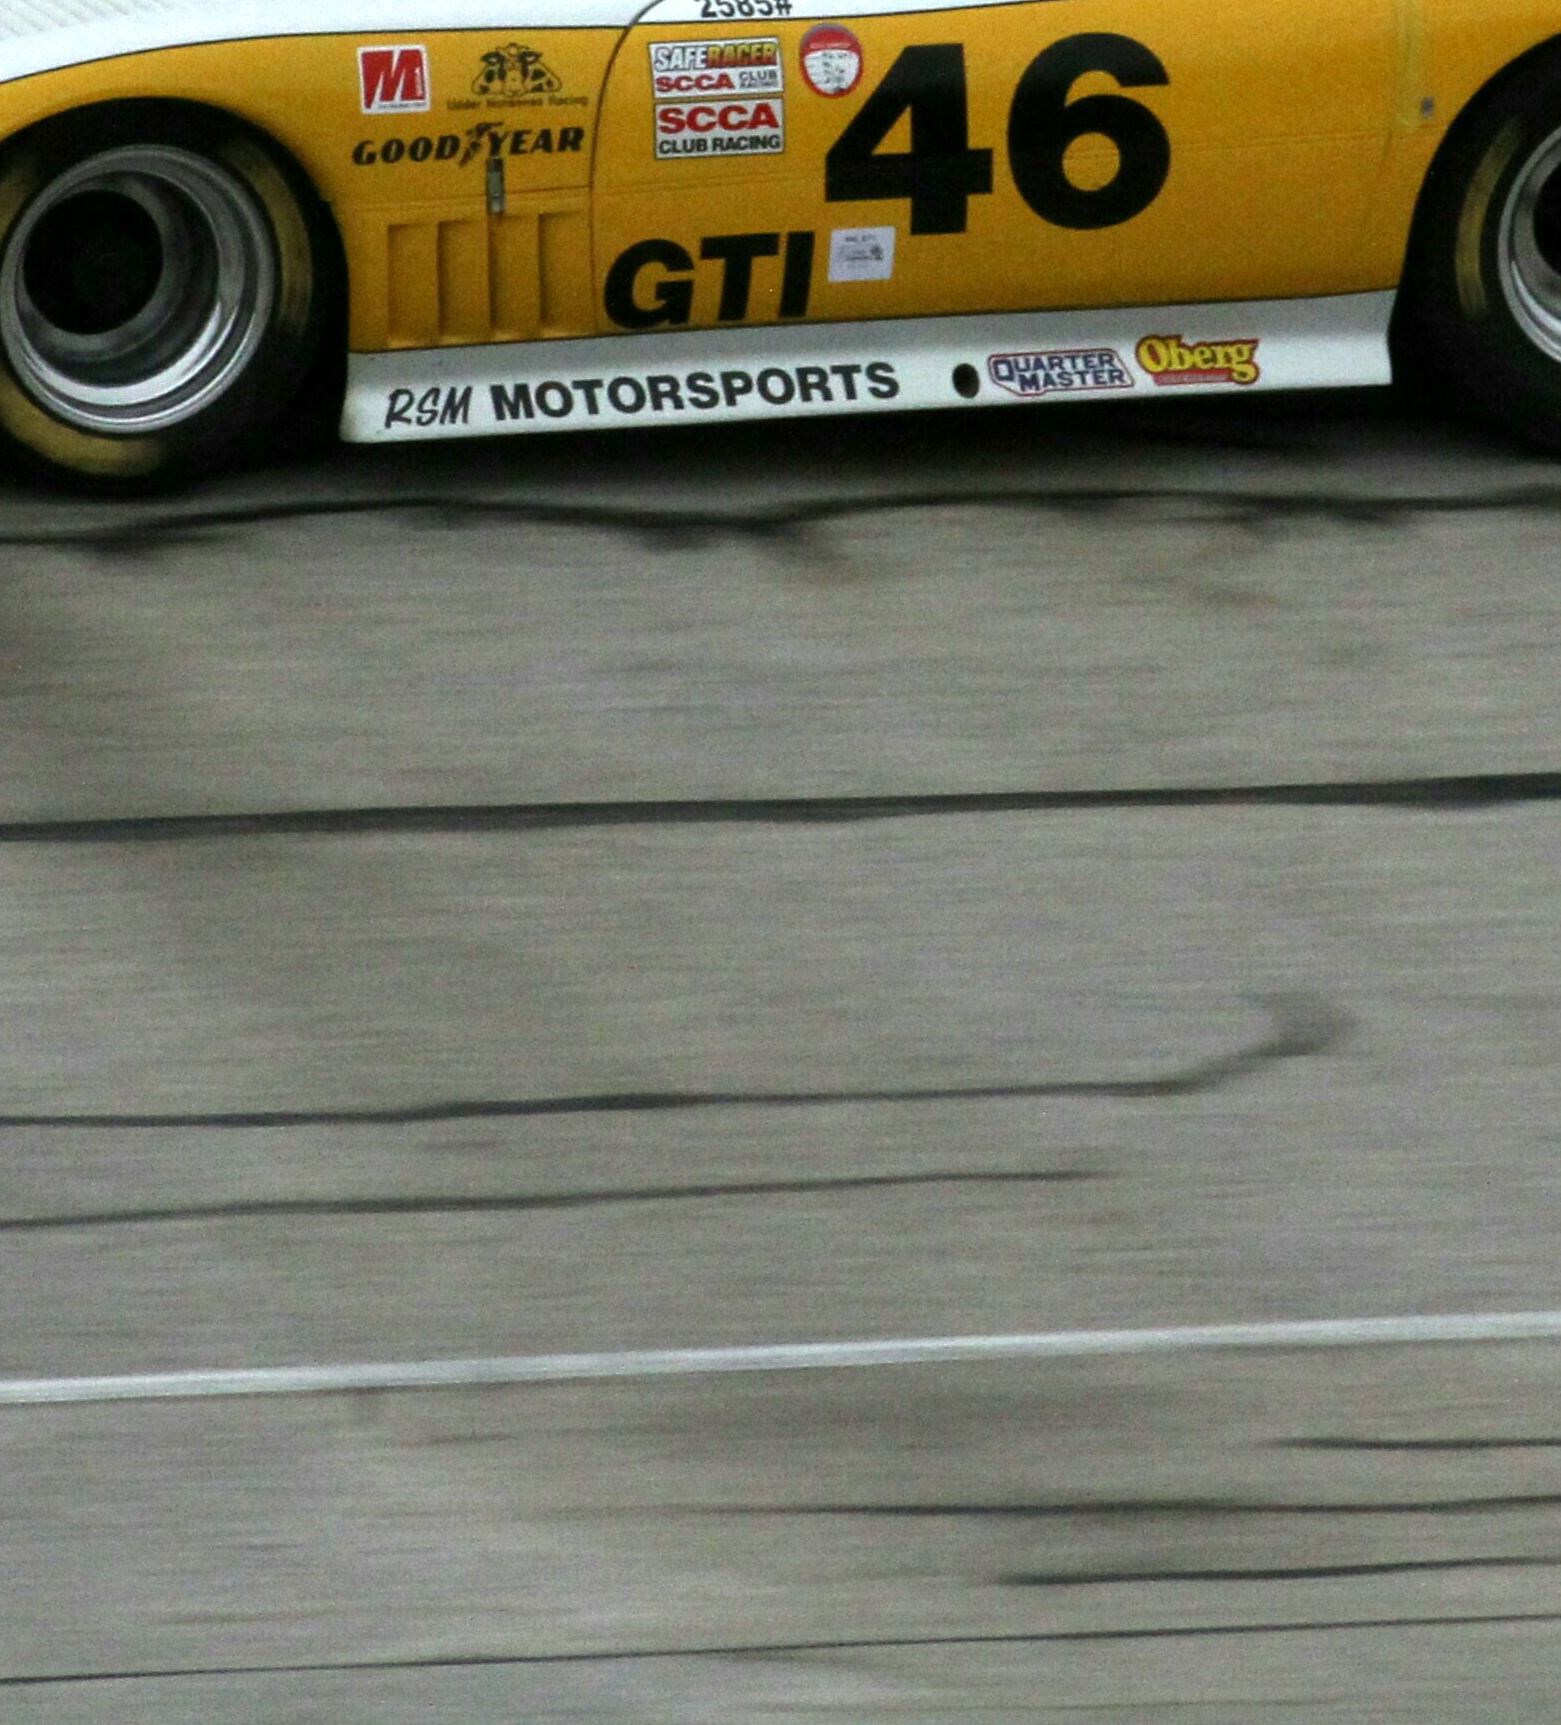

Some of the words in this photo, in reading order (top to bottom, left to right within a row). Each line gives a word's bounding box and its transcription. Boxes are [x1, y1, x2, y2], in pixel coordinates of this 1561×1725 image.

[655, 73, 735, 92] SCCA
[739, 70, 778, 81] CLUB
[658, 102, 780, 134] SCCA
[825, 32, 1171, 236] 46
[659, 138, 708, 154] CLUB
[711, 135, 780, 152] RACING
[603, 231, 816, 332] GTI
[992, 352, 1116, 382] QUARTER
[1137, 336, 1258, 384] Oberg
[384, 385, 473, 428] RSM
[490, 361, 901, 422] MOTORSPORTS
[1018, 368, 1127, 393] MASTER
